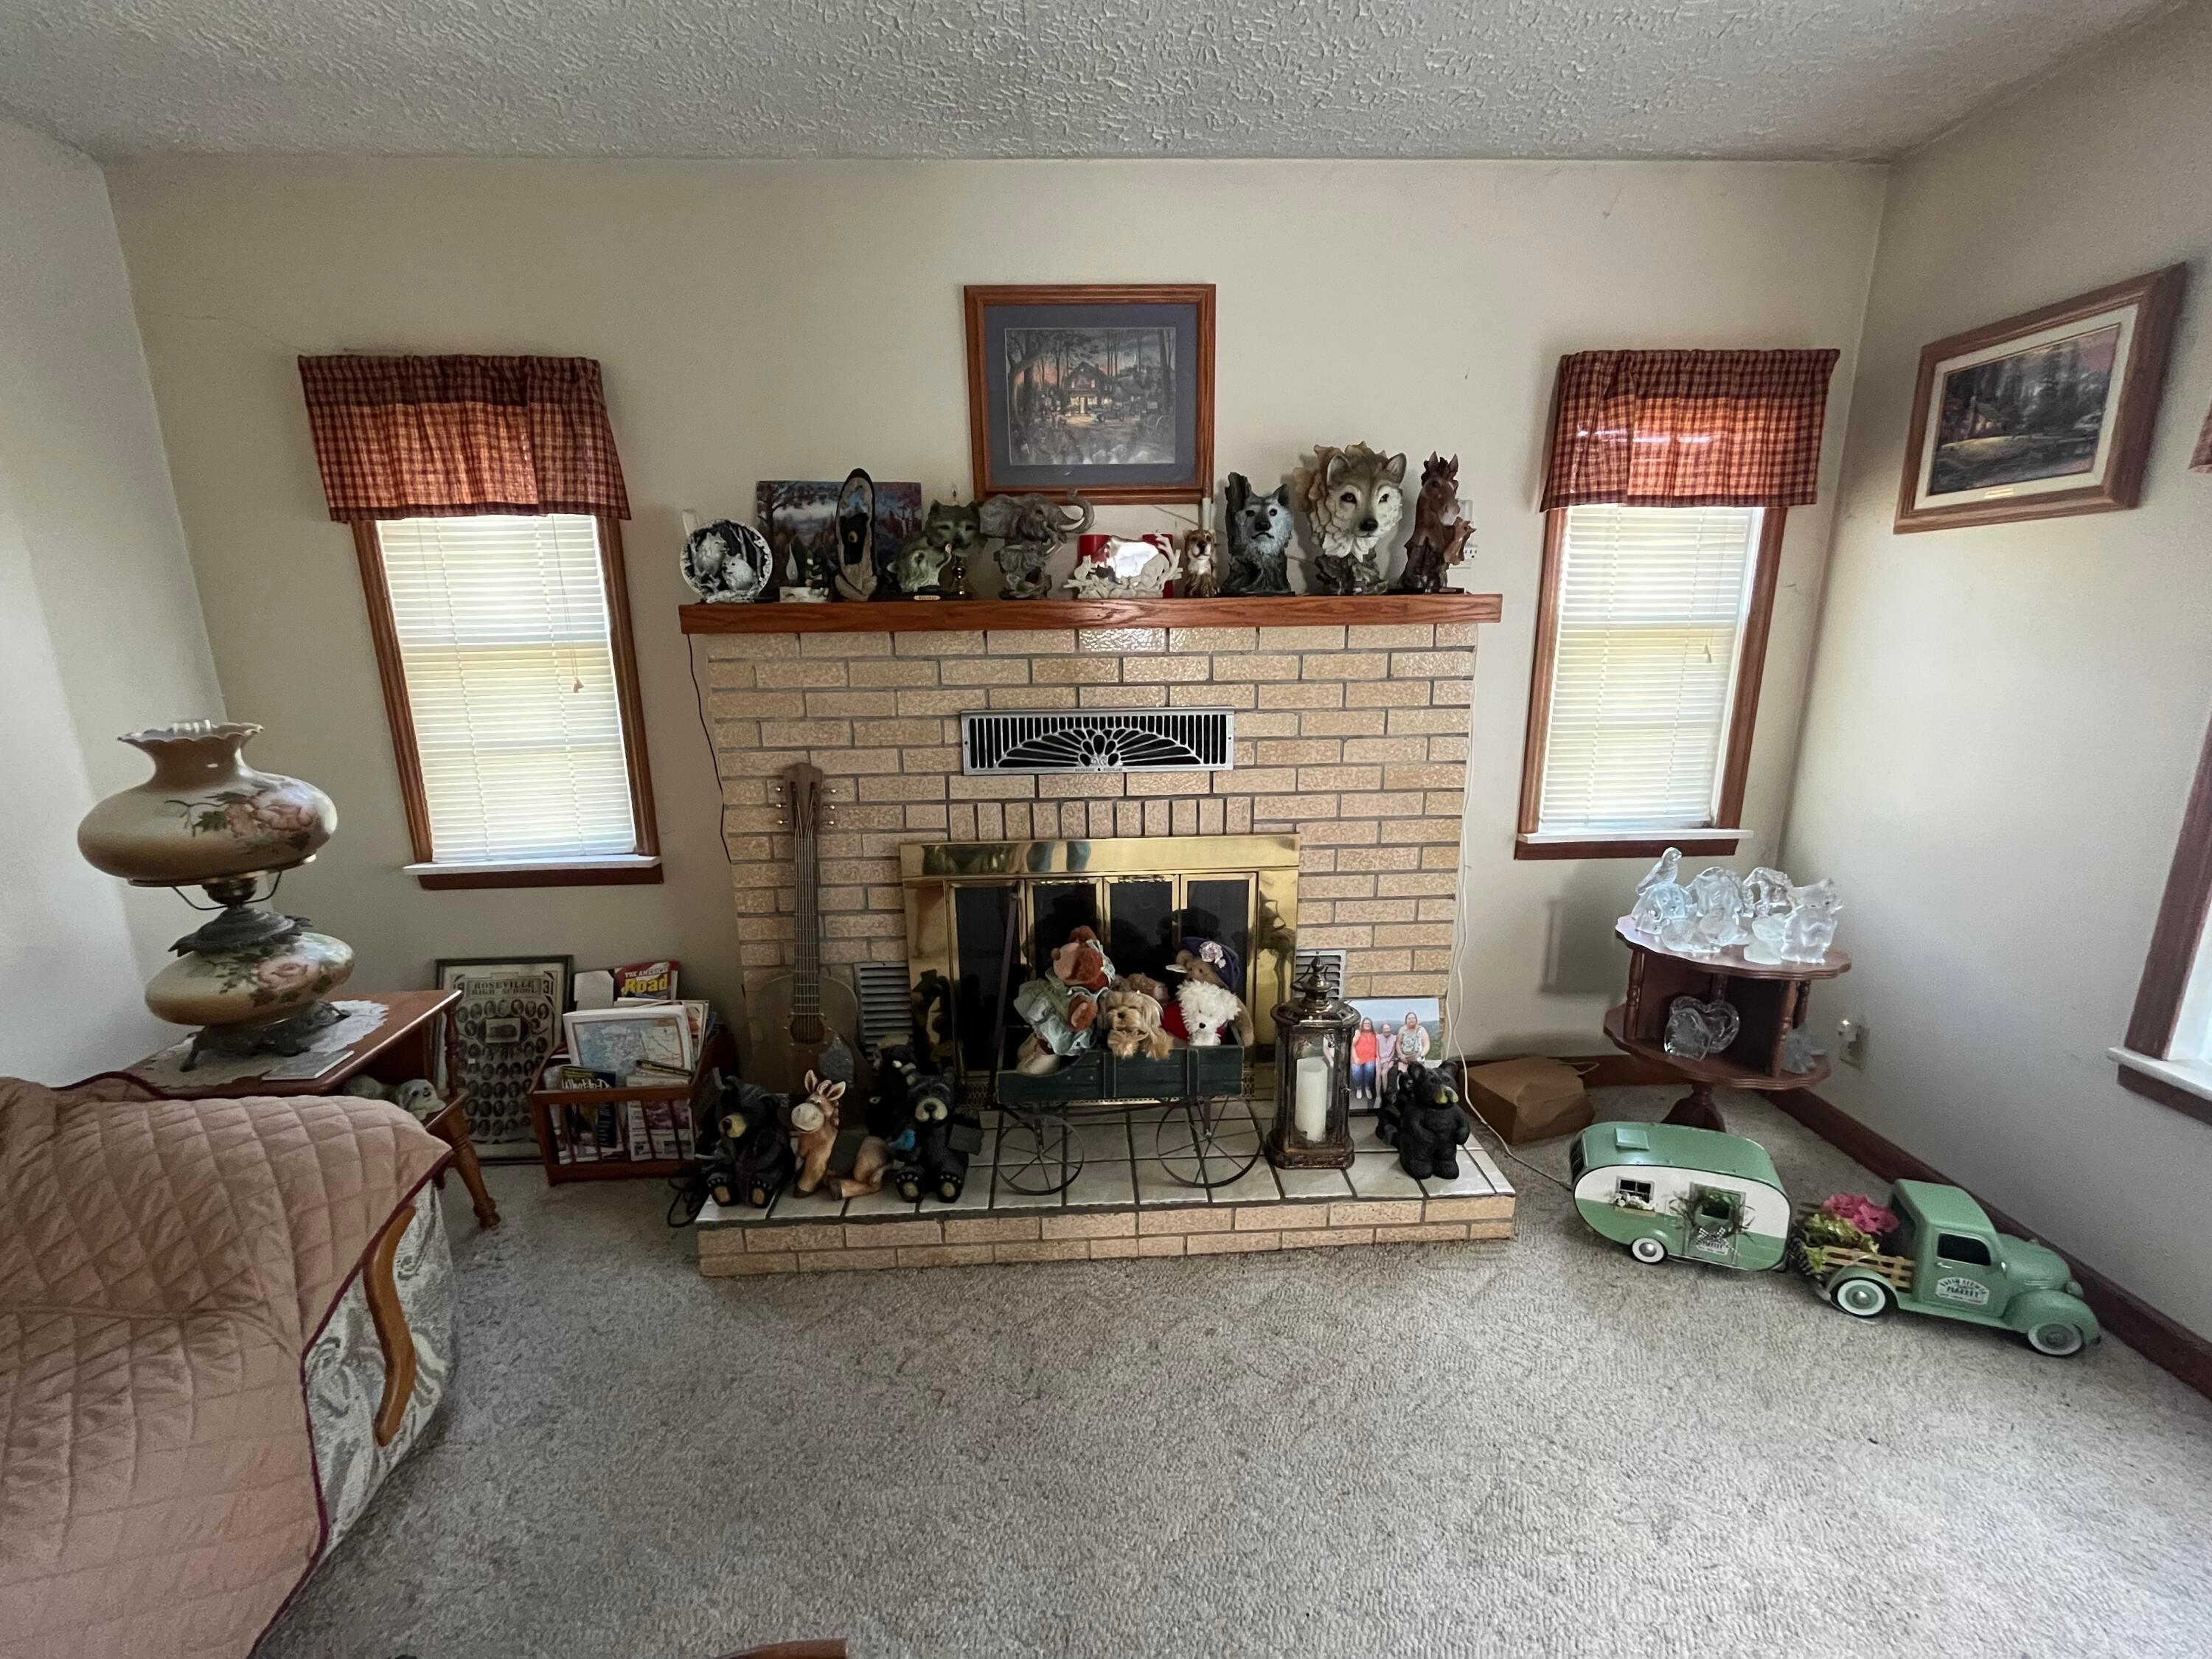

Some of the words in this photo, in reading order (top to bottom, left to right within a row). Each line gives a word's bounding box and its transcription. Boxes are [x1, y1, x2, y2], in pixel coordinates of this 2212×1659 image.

[474, 979, 535, 990] ROSEVILLE
[543, 980, 554, 995] 31
[625, 973, 668, 993] Road
